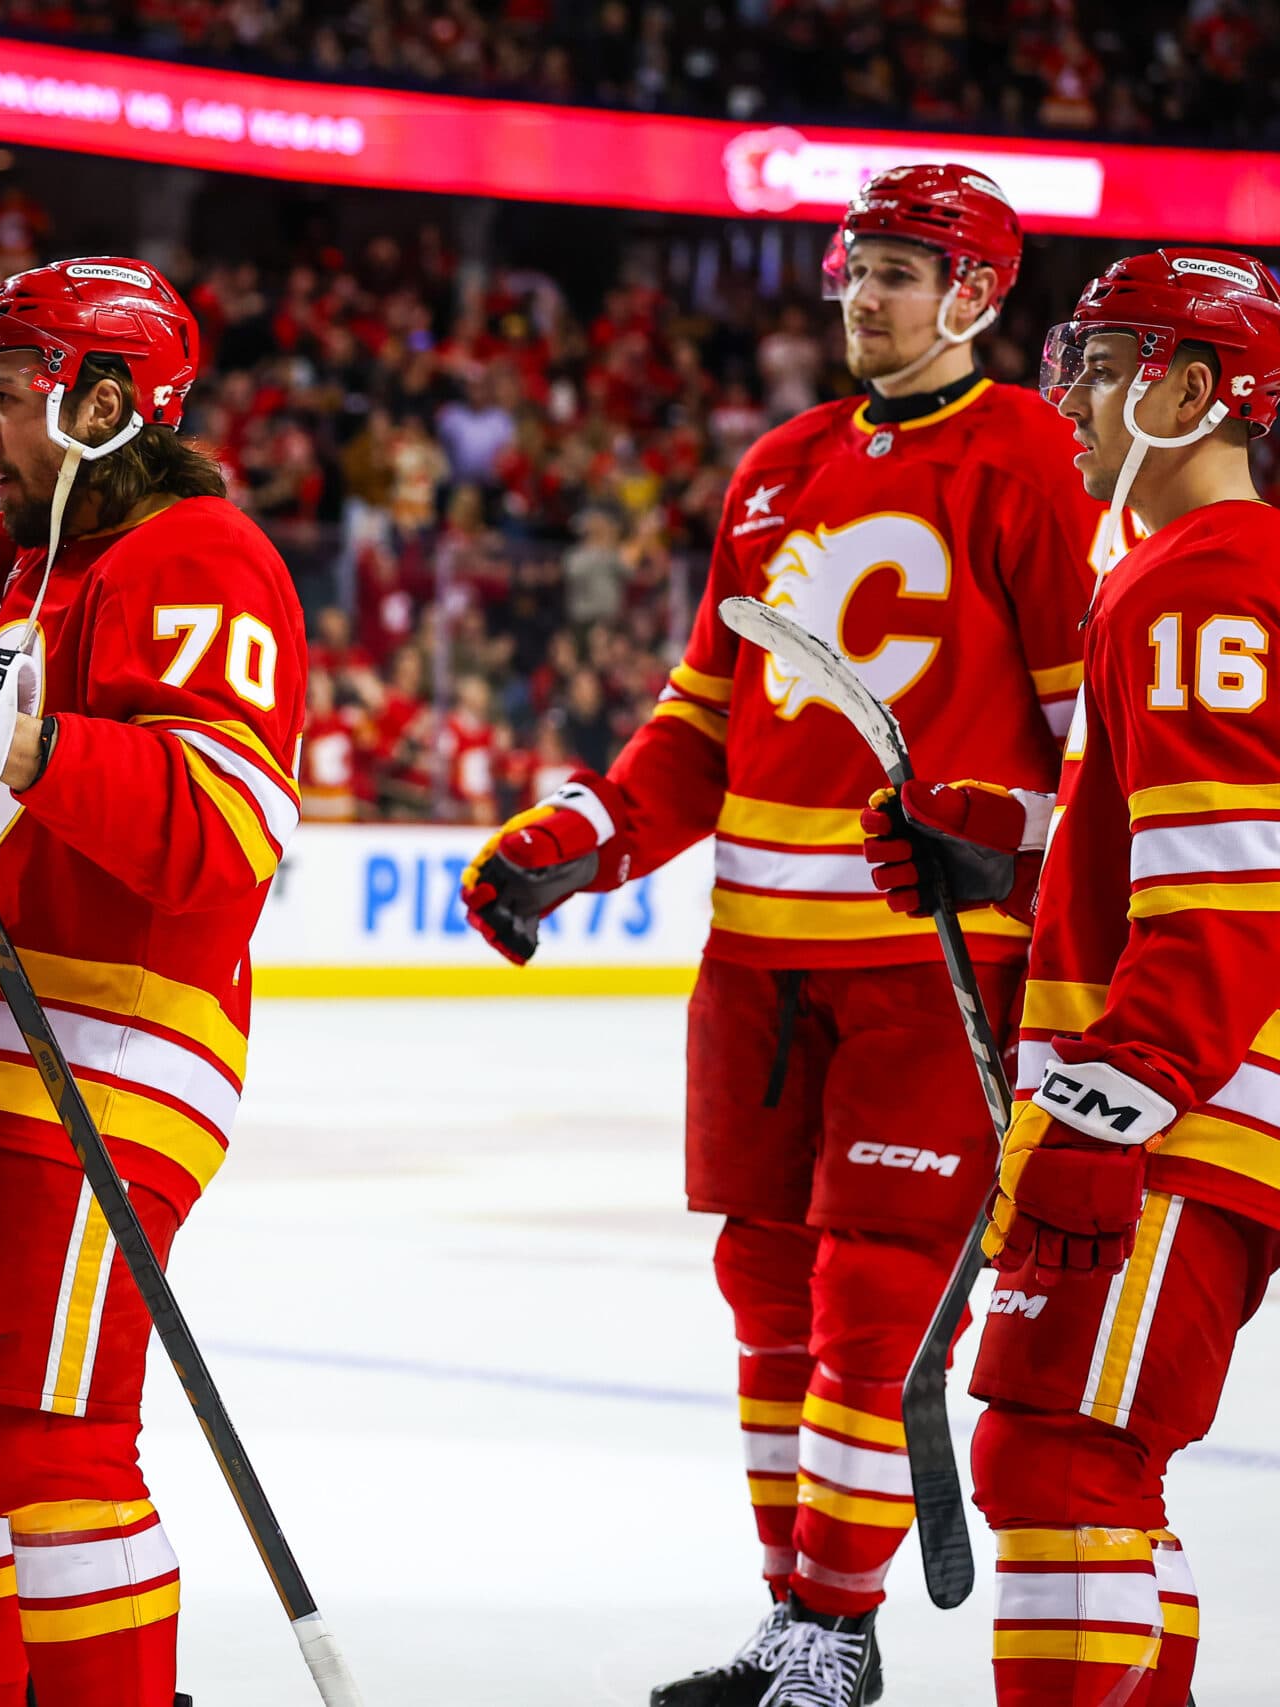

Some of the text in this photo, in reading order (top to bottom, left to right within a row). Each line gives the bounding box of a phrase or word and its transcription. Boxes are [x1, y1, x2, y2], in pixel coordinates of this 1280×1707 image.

[72, 266, 147, 285] GameSense
[1178, 259, 1253, 285] GameSense
[153, 604, 278, 712] 70
[1147, 612, 1269, 714] 16
[363, 856, 560, 935] PIZ
[1044, 1068, 1142, 1133] CM
[847, 1140, 961, 1178] CCM
